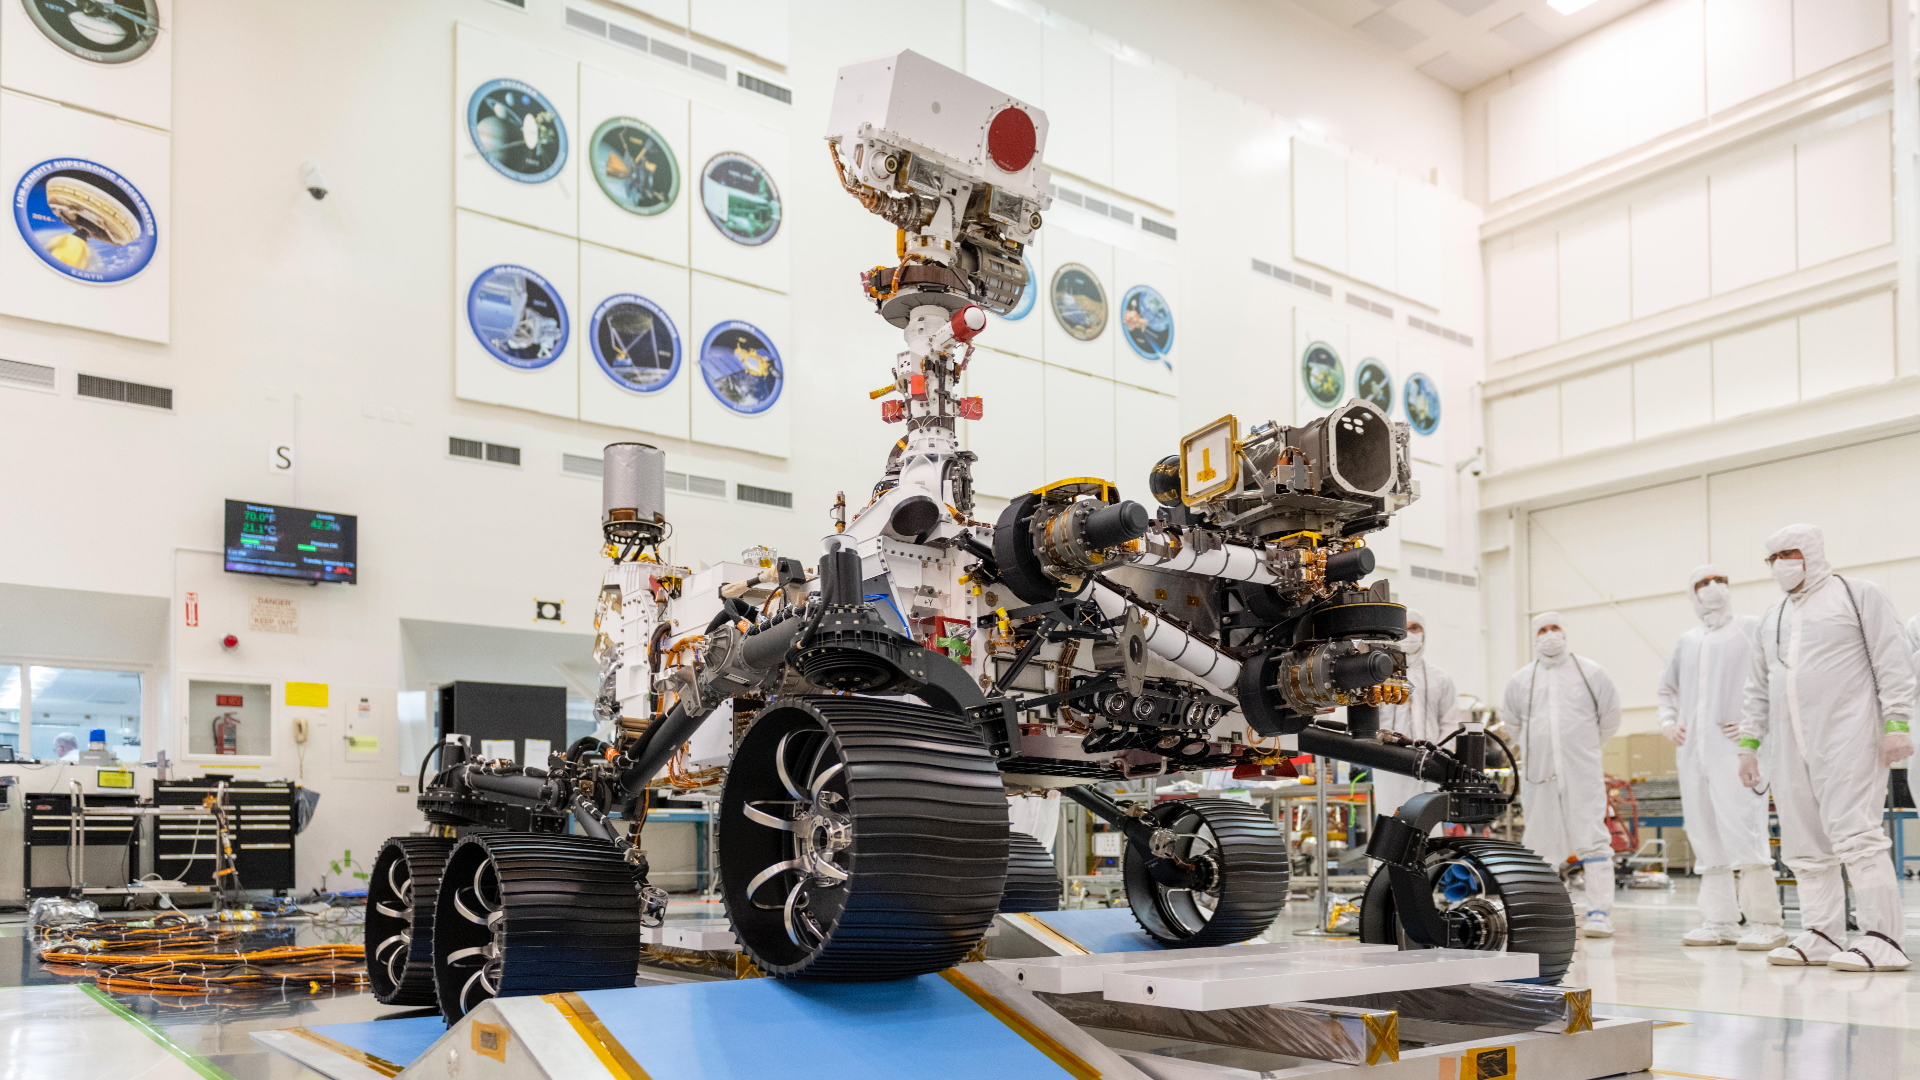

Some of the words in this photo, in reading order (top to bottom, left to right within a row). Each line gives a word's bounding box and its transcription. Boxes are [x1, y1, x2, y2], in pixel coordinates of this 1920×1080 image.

[16, 162, 53, 208] LOW-DENSITY
[54, 159, 116, 179] SUPERSONIC
[116, 176, 155, 237] DECELERATOR
[71, 268, 104, 281] EARTH
[276, 446, 291, 470] S
